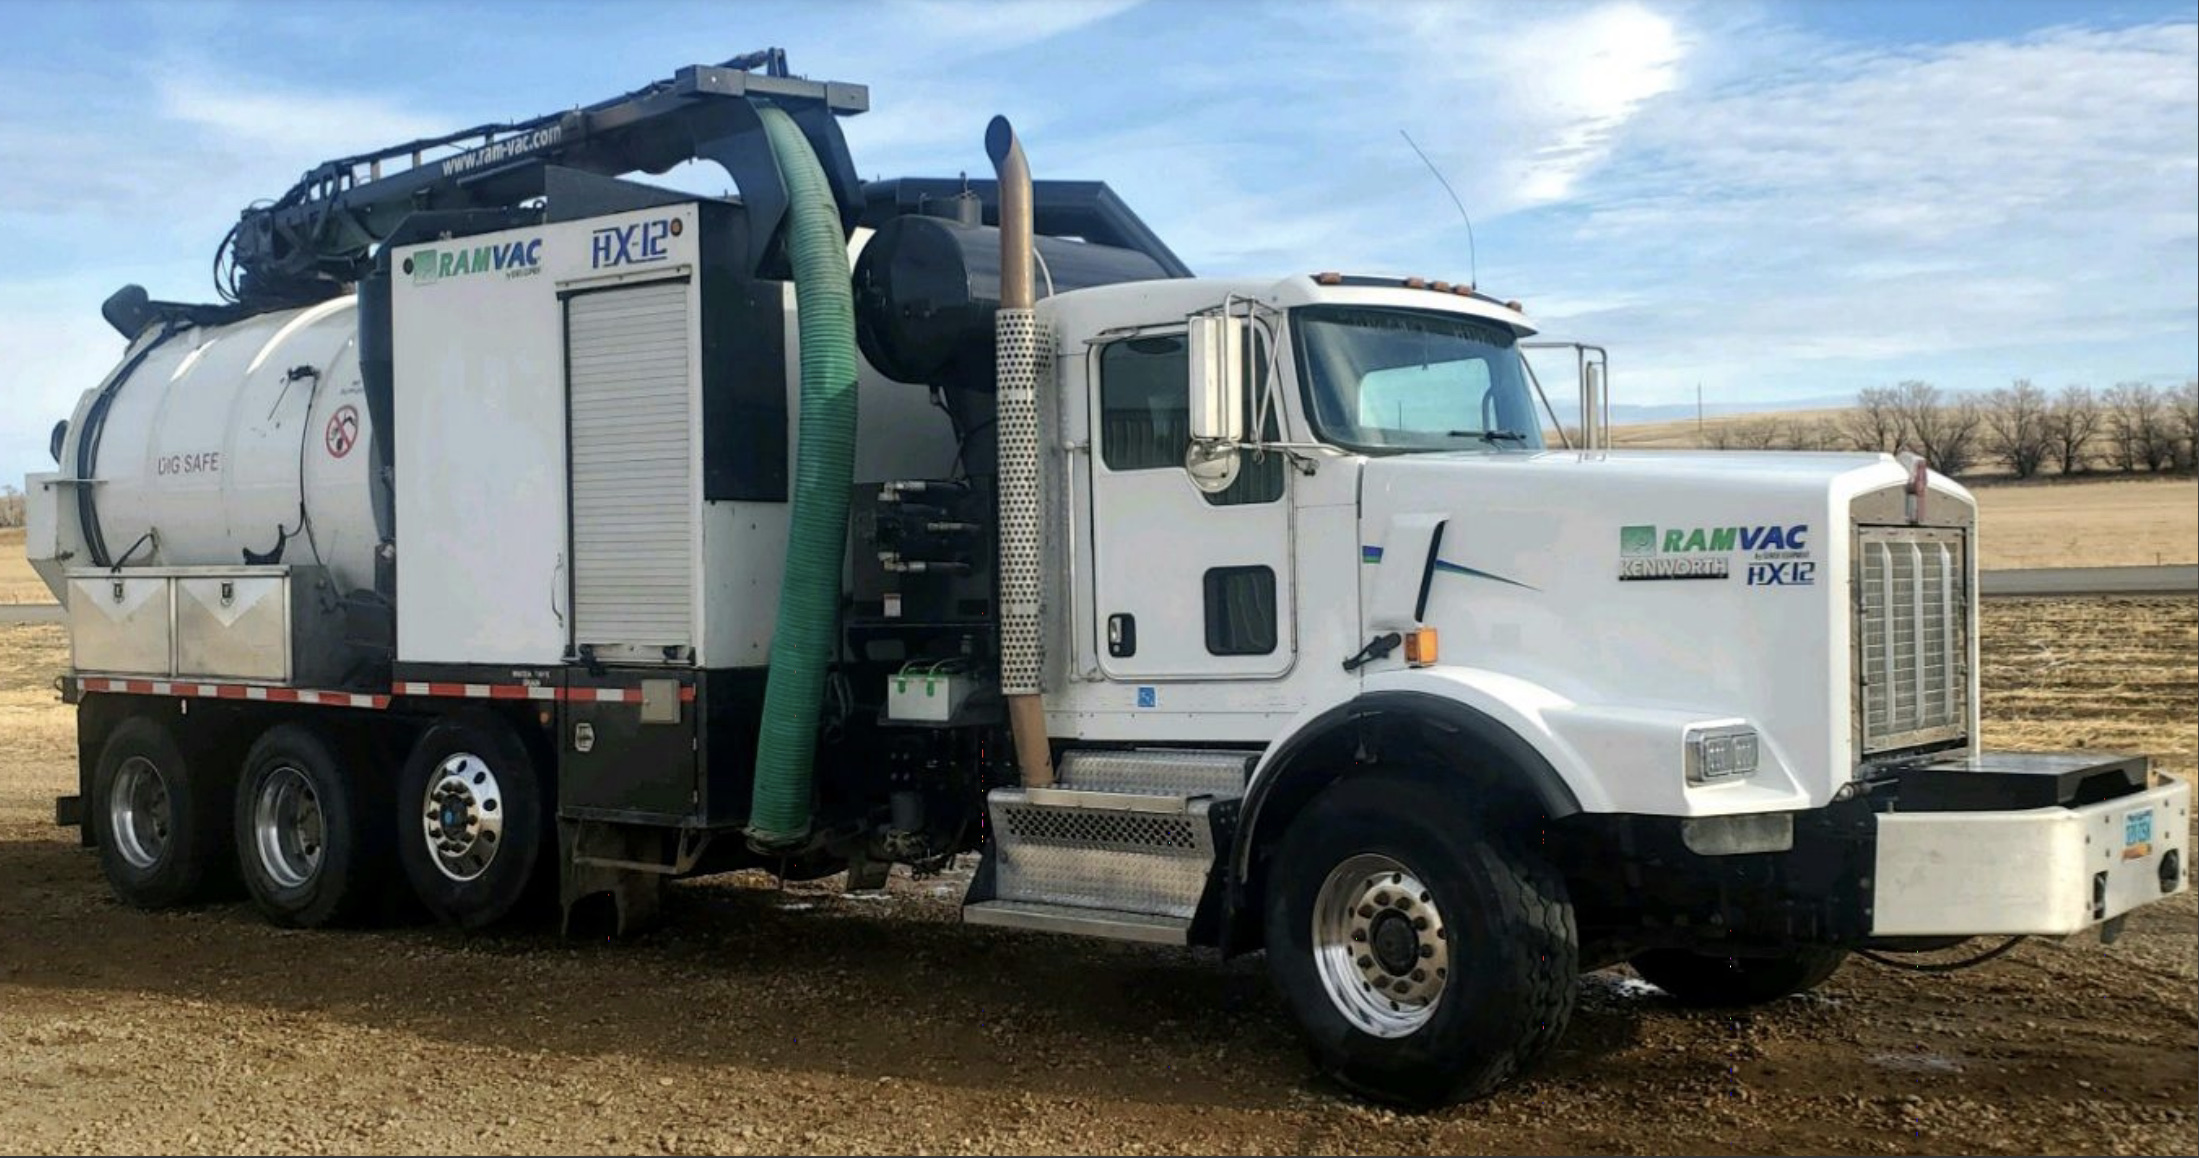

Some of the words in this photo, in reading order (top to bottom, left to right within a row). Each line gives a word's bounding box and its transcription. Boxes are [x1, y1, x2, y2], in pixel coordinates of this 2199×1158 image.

[592, 219, 668, 269] HX-12
[438, 238, 542, 278] RAMVAC
[184, 452, 219, 473] SAFE
[1662, 525, 1808, 551] RAMVAC
[1619, 558, 1728, 576] KENWORTH
[1747, 562, 1815, 585] HX-12
